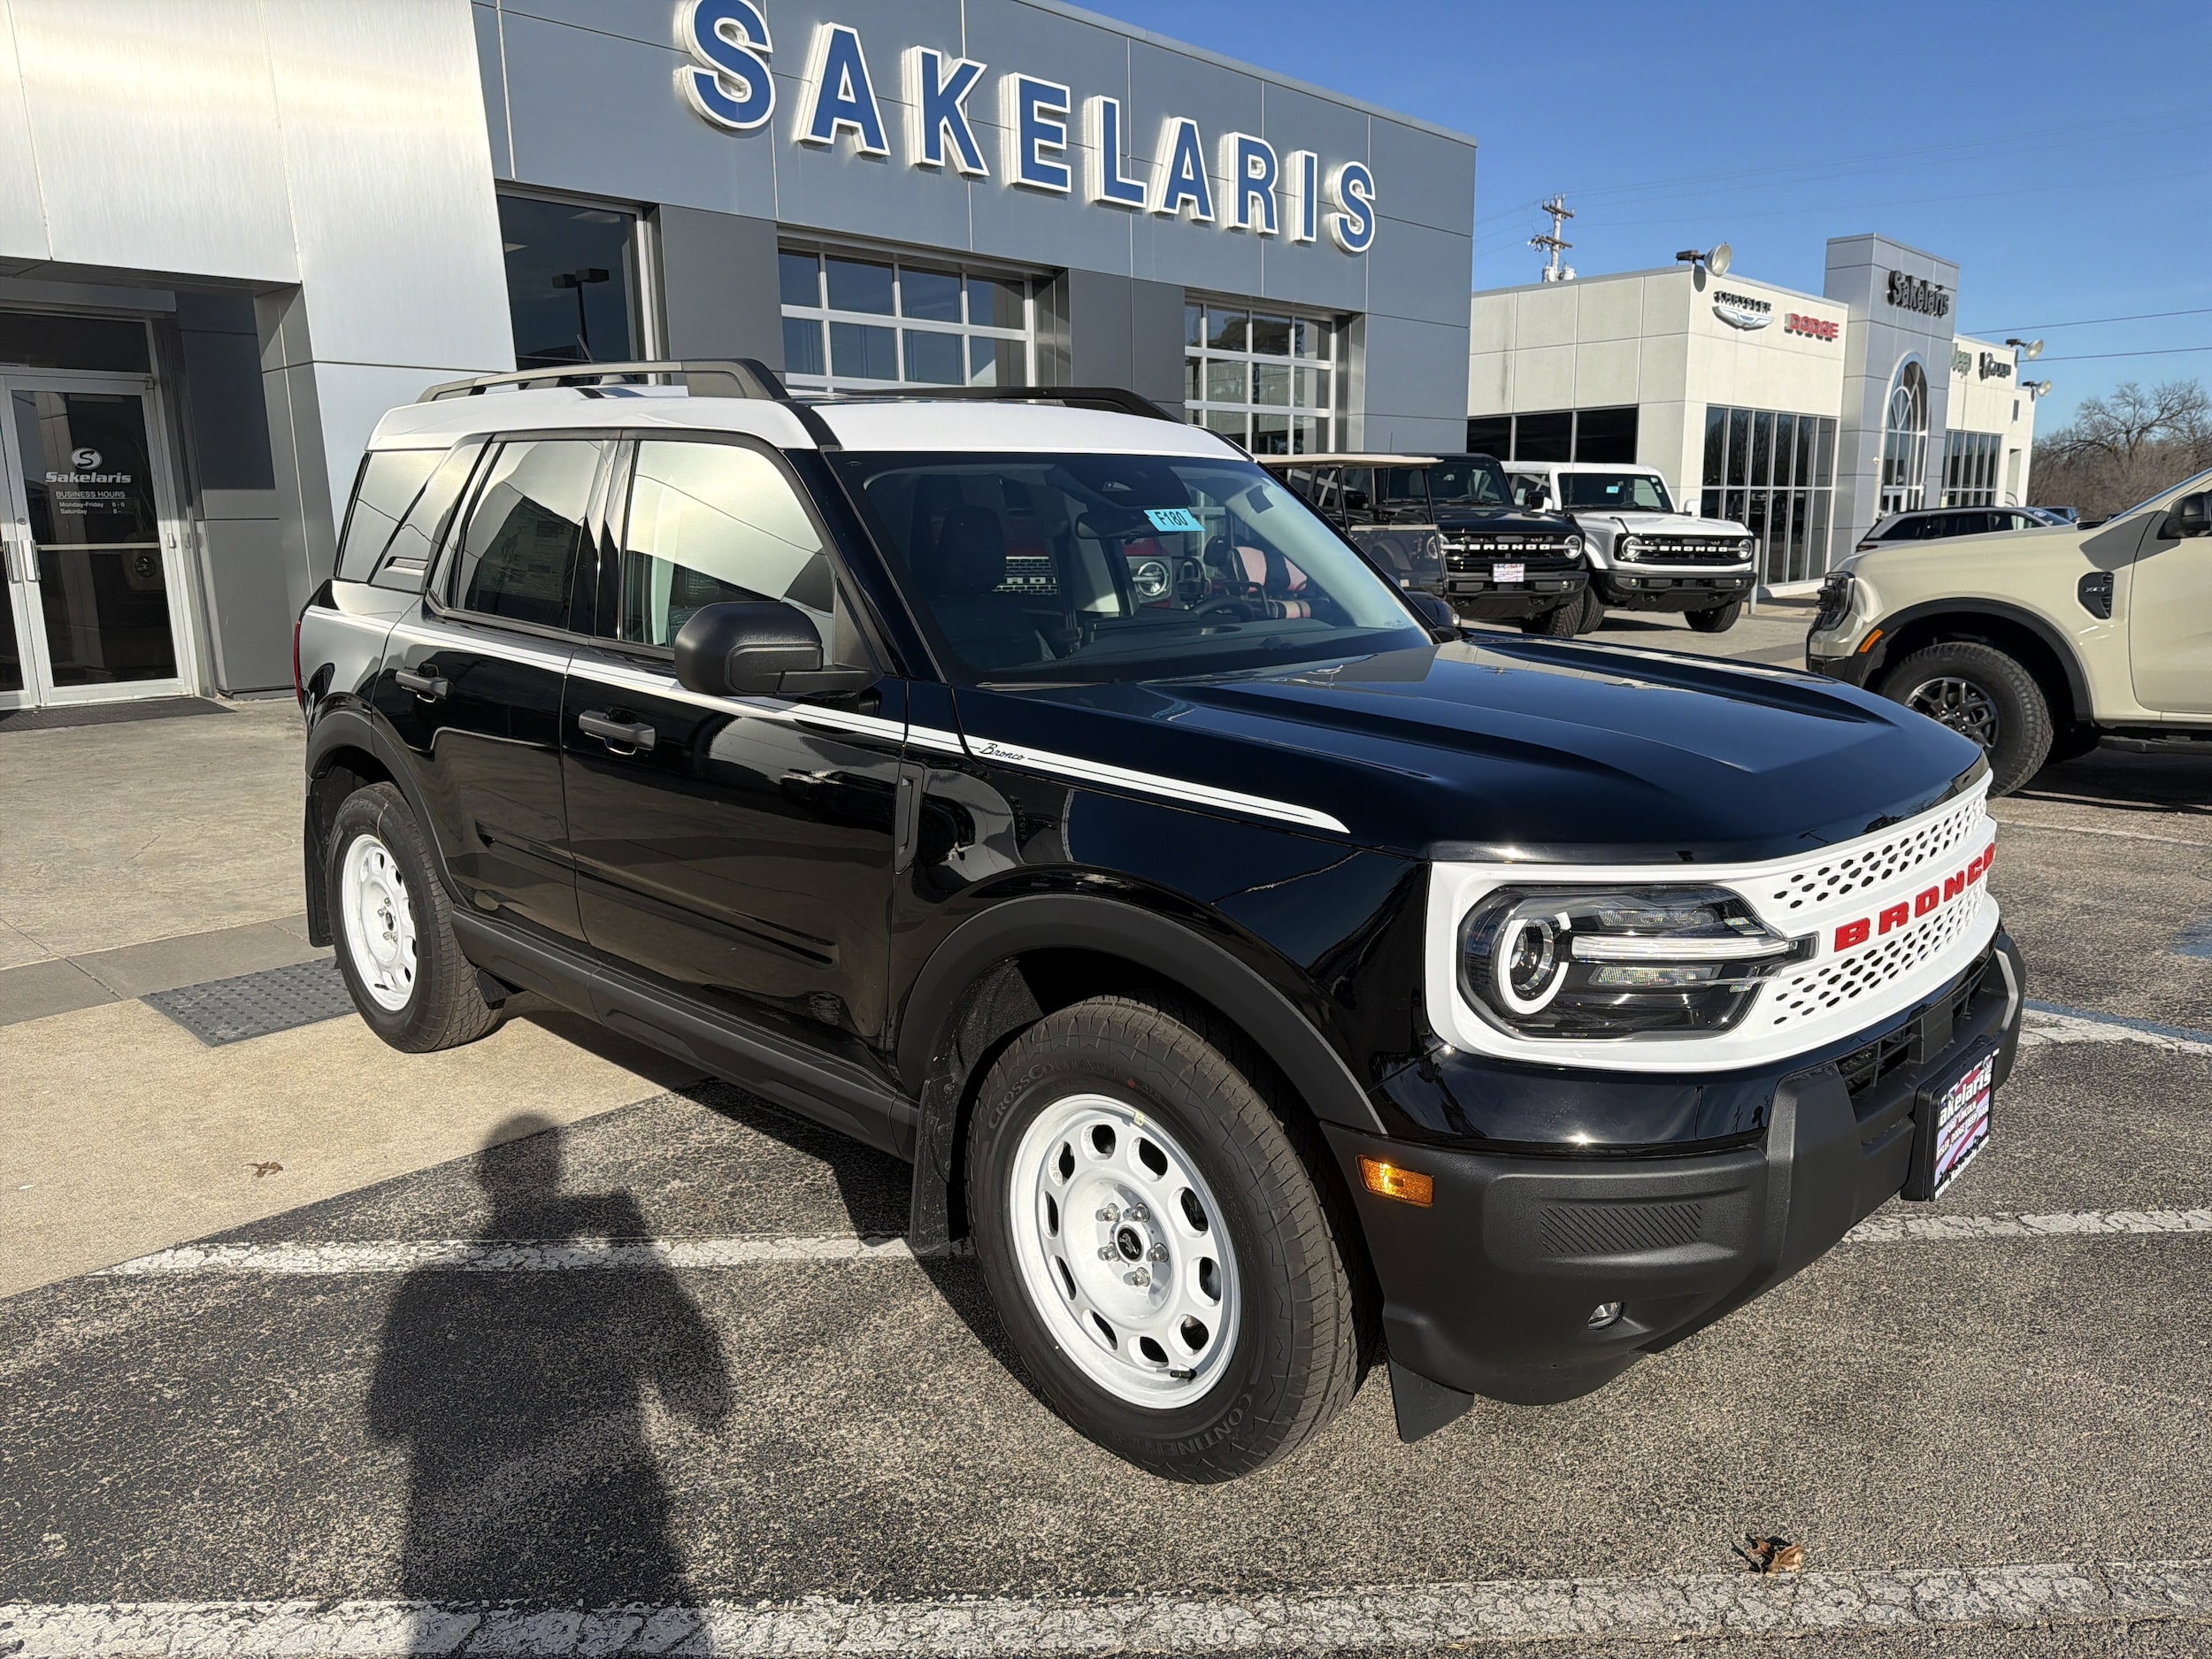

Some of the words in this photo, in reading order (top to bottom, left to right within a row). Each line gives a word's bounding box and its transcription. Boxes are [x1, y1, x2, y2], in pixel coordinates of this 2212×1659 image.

[679, 0, 1375, 252] SAKELARIS
[1888, 270, 1949, 318] Sakelaris
[1786, 312, 1839, 340] DODGE
[44, 472, 132, 484] Sakelaris
[1154, 511, 1188, 526] F180
[979, 742, 1025, 761] Bronco
[1834, 842, 1995, 953] BRONCO
[1937, 1068, 1992, 1128] akelaris
[1957, 1100, 1978, 1123] LINCOLN
[1951, 1123, 1965, 1144] DODGE
[1964, 1112, 1978, 1130] JEEP
